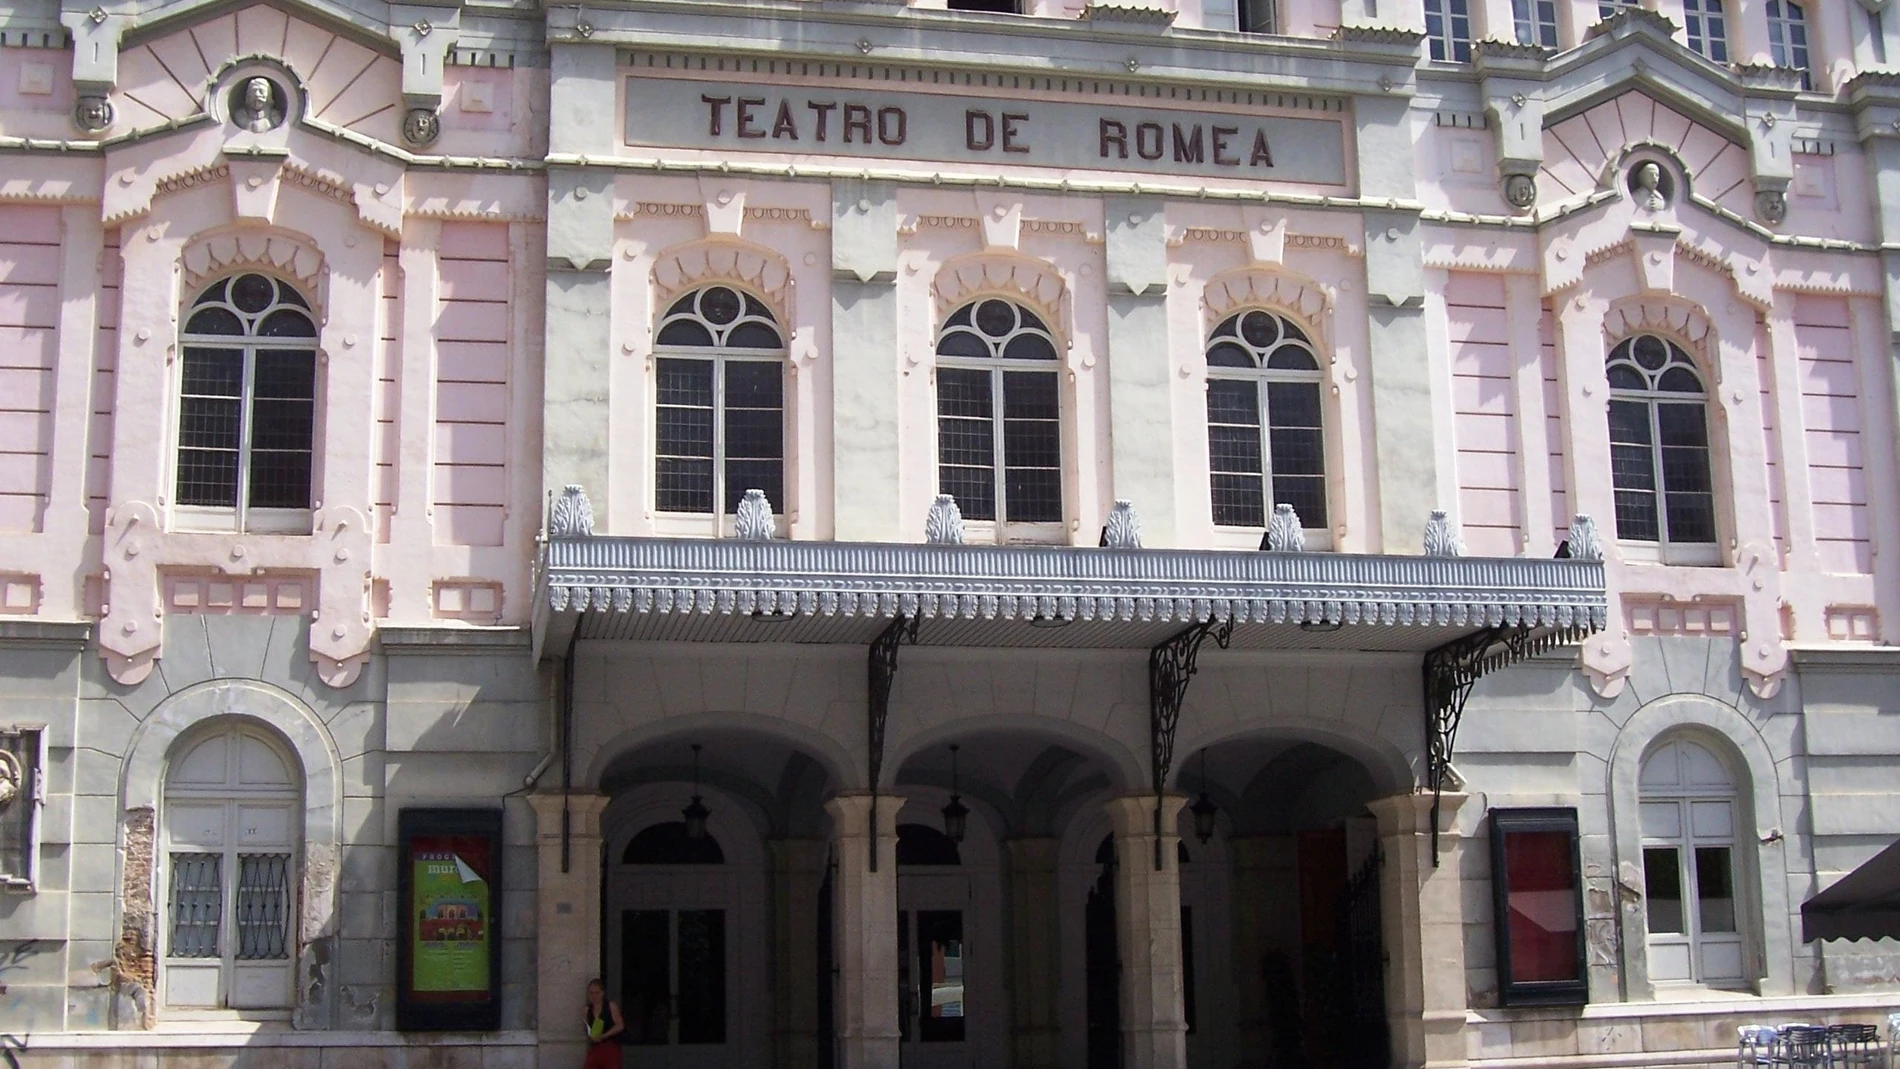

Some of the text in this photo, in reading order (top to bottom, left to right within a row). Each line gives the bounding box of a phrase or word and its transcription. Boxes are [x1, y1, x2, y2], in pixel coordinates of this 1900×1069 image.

[702, 94, 1274, 167] TEATRO DE ROMEA
